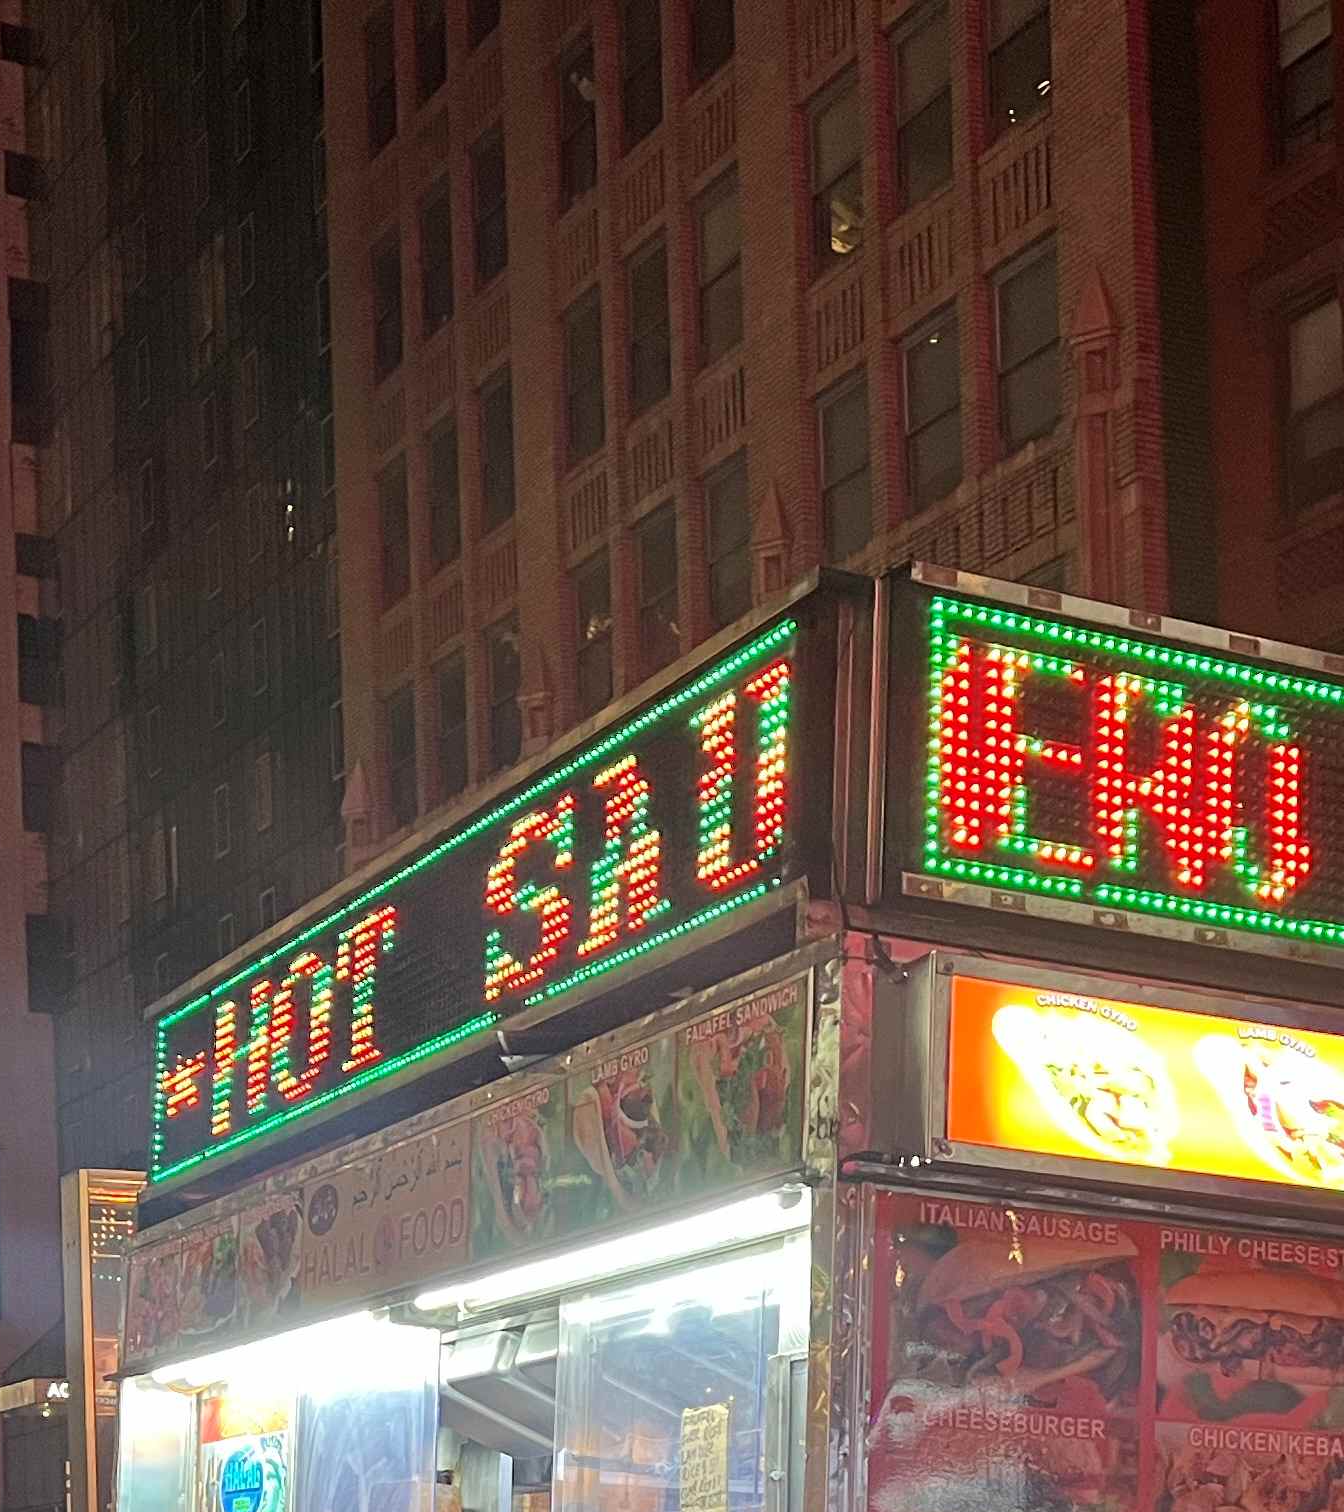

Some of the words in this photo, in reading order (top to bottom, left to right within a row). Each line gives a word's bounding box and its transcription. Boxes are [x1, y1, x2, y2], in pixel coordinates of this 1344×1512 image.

[210, 904, 397, 1136] HOT
[735, 986, 799, 1026] SANDWICH
[620, 1046, 649, 1073] GYRO
[303, 1230, 371, 1289] HALAL
[398, 1195, 466, 1260] FOOD
[919, 1202, 1005, 1233] ITALIAN
[1013, 1213, 1119, 1245] SAUSAGE
[1160, 1229, 1231, 1257] PHILLY
[1237, 1238, 1322, 1266] CHEESE
[922, 1408, 1106, 1440] CHEESEBURGER
[1189, 1426, 1281, 1454] CHICKEN
